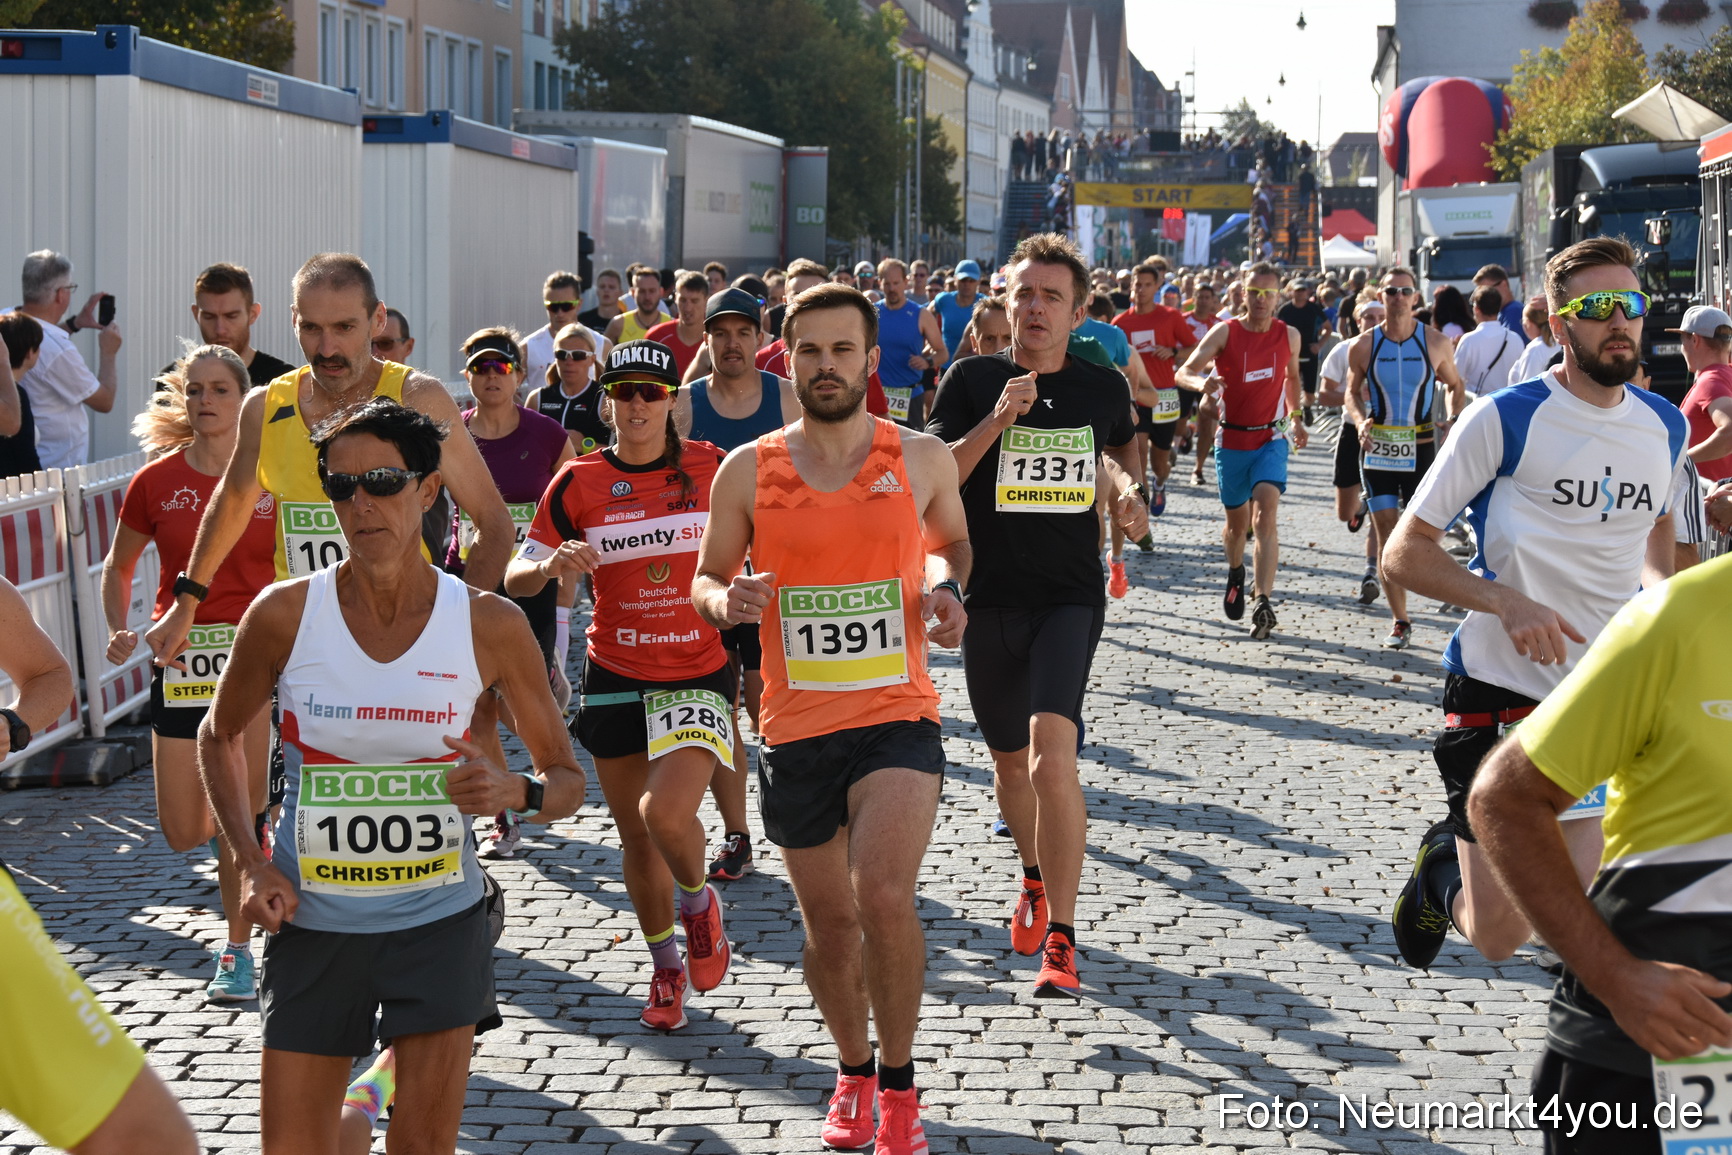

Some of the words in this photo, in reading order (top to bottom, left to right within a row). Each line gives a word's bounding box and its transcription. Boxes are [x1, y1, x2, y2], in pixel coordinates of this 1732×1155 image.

[1132, 187, 1194, 203] START
[611, 346, 671, 370] OAKLEY
[1010, 431, 1088, 450] BOCK
[1372, 442, 1411, 457] 2590
[1012, 456, 1085, 482] 1331
[870, 484, 904, 492] adidas
[1006, 490, 1085, 502] CHRISTIAN
[1552, 466, 1653, 522] SUSPA
[161, 500, 185, 511] Spitz
[291, 508, 338, 530] BO
[299, 541, 344, 571] 10
[639, 586, 678, 598] Deutsche
[789, 585, 892, 612] BOCK
[619, 597, 692, 612] Vermögensberatun
[188, 627, 237, 646] OC
[640, 630, 700, 644] Einhell
[797, 618, 887, 655] 1391
[175, 653, 229, 677] 100
[173, 685, 218, 697] STEPH
[654, 689, 728, 715] BOCK
[303, 693, 352, 719] team
[356, 702, 458, 725] memmert
[659, 706, 728, 740] 1289
[674, 730, 718, 747] VIOLA
[312, 771, 445, 801] BOCK
[1573, 790, 1601, 806] AX
[316, 814, 444, 854] 1003
[316, 858, 445, 882] CHRISTINE
